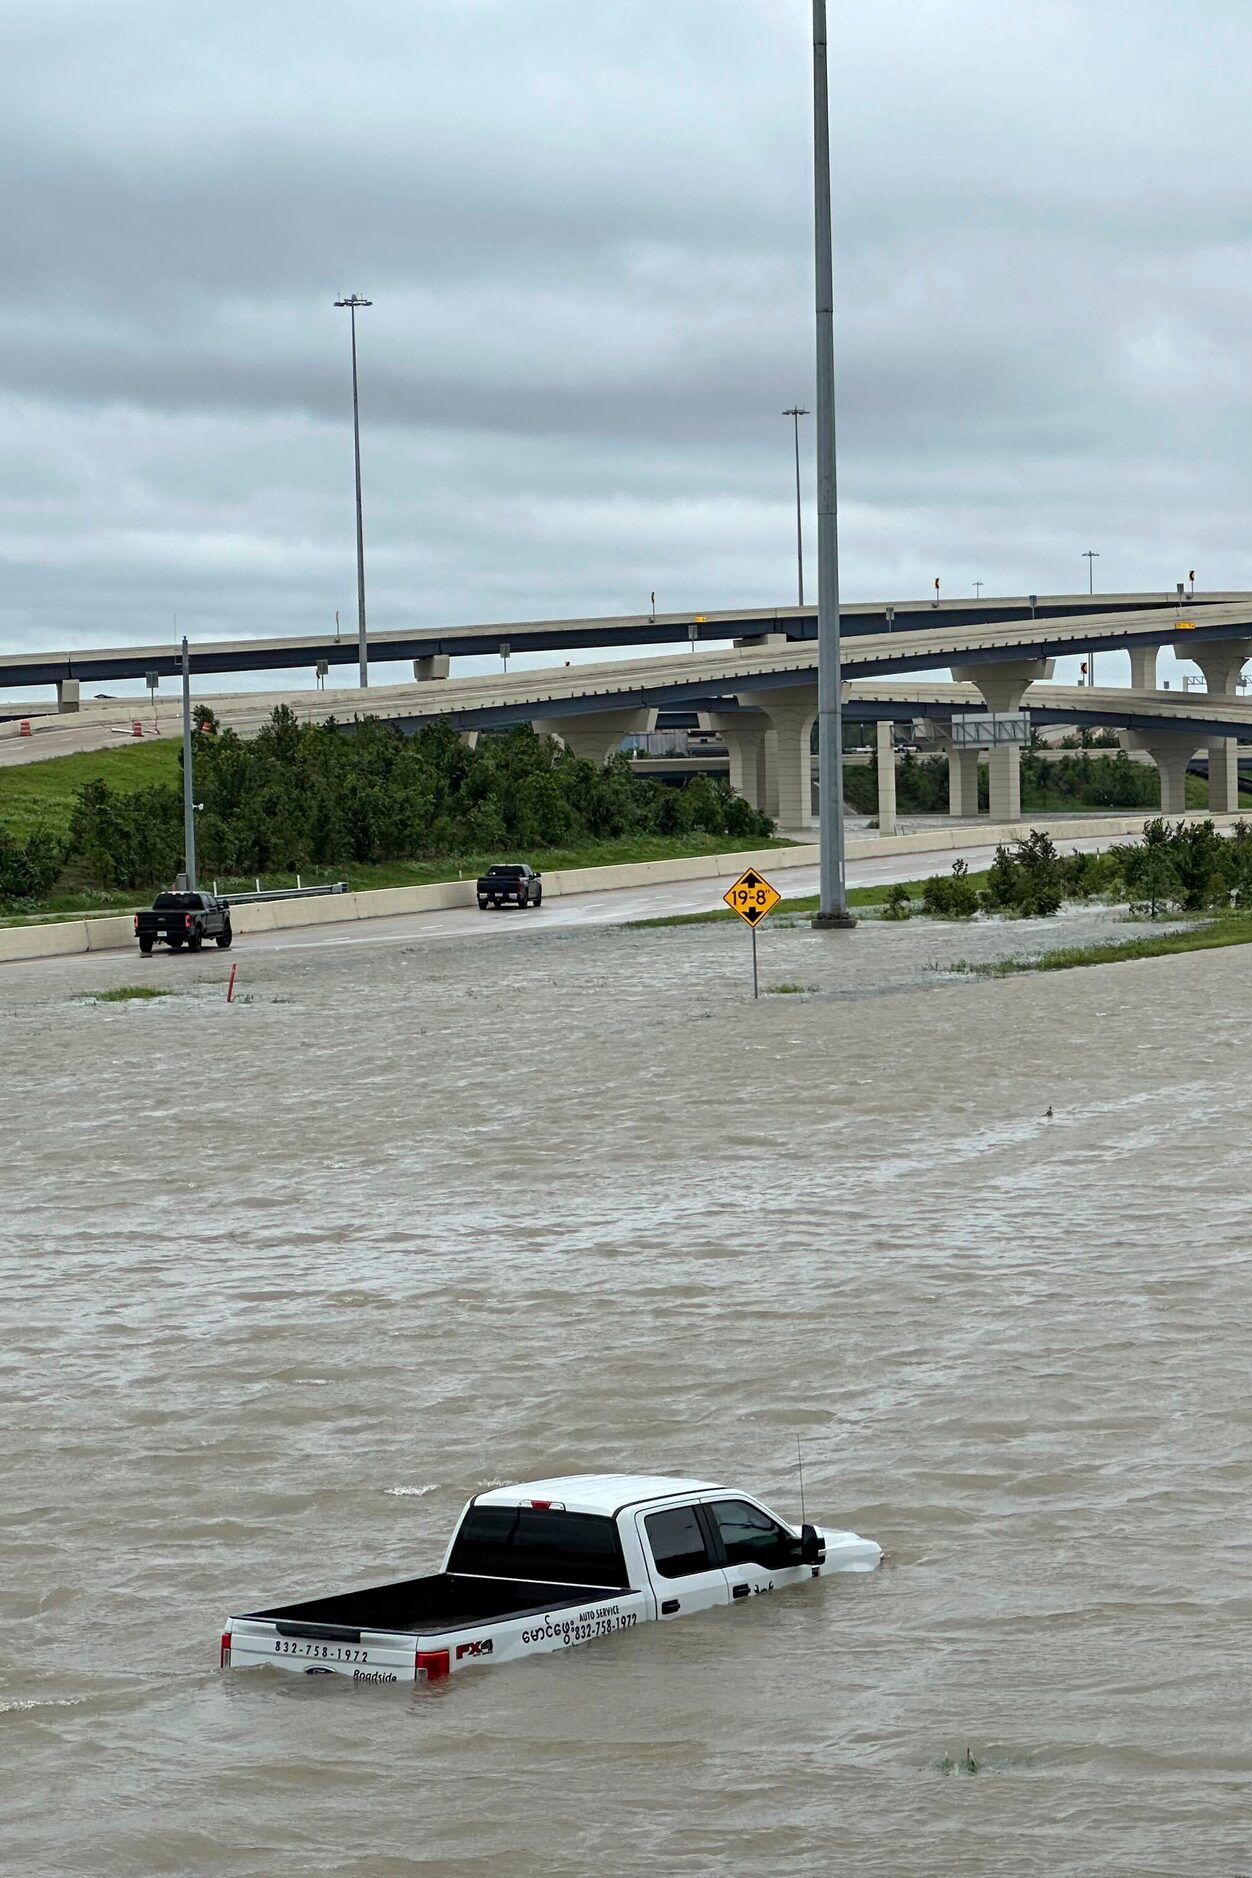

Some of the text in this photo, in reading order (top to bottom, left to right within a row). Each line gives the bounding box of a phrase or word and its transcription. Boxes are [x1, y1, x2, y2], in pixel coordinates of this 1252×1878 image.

[579, 1605, 620, 1622] AUTO SERVICE
[574, 1613, 637, 1640] 832-758-1972
[274, 1640, 369, 1663] 832-758-1972
[455, 1638, 494, 1660] FX4
[353, 1669, 398, 1684] Roadside
